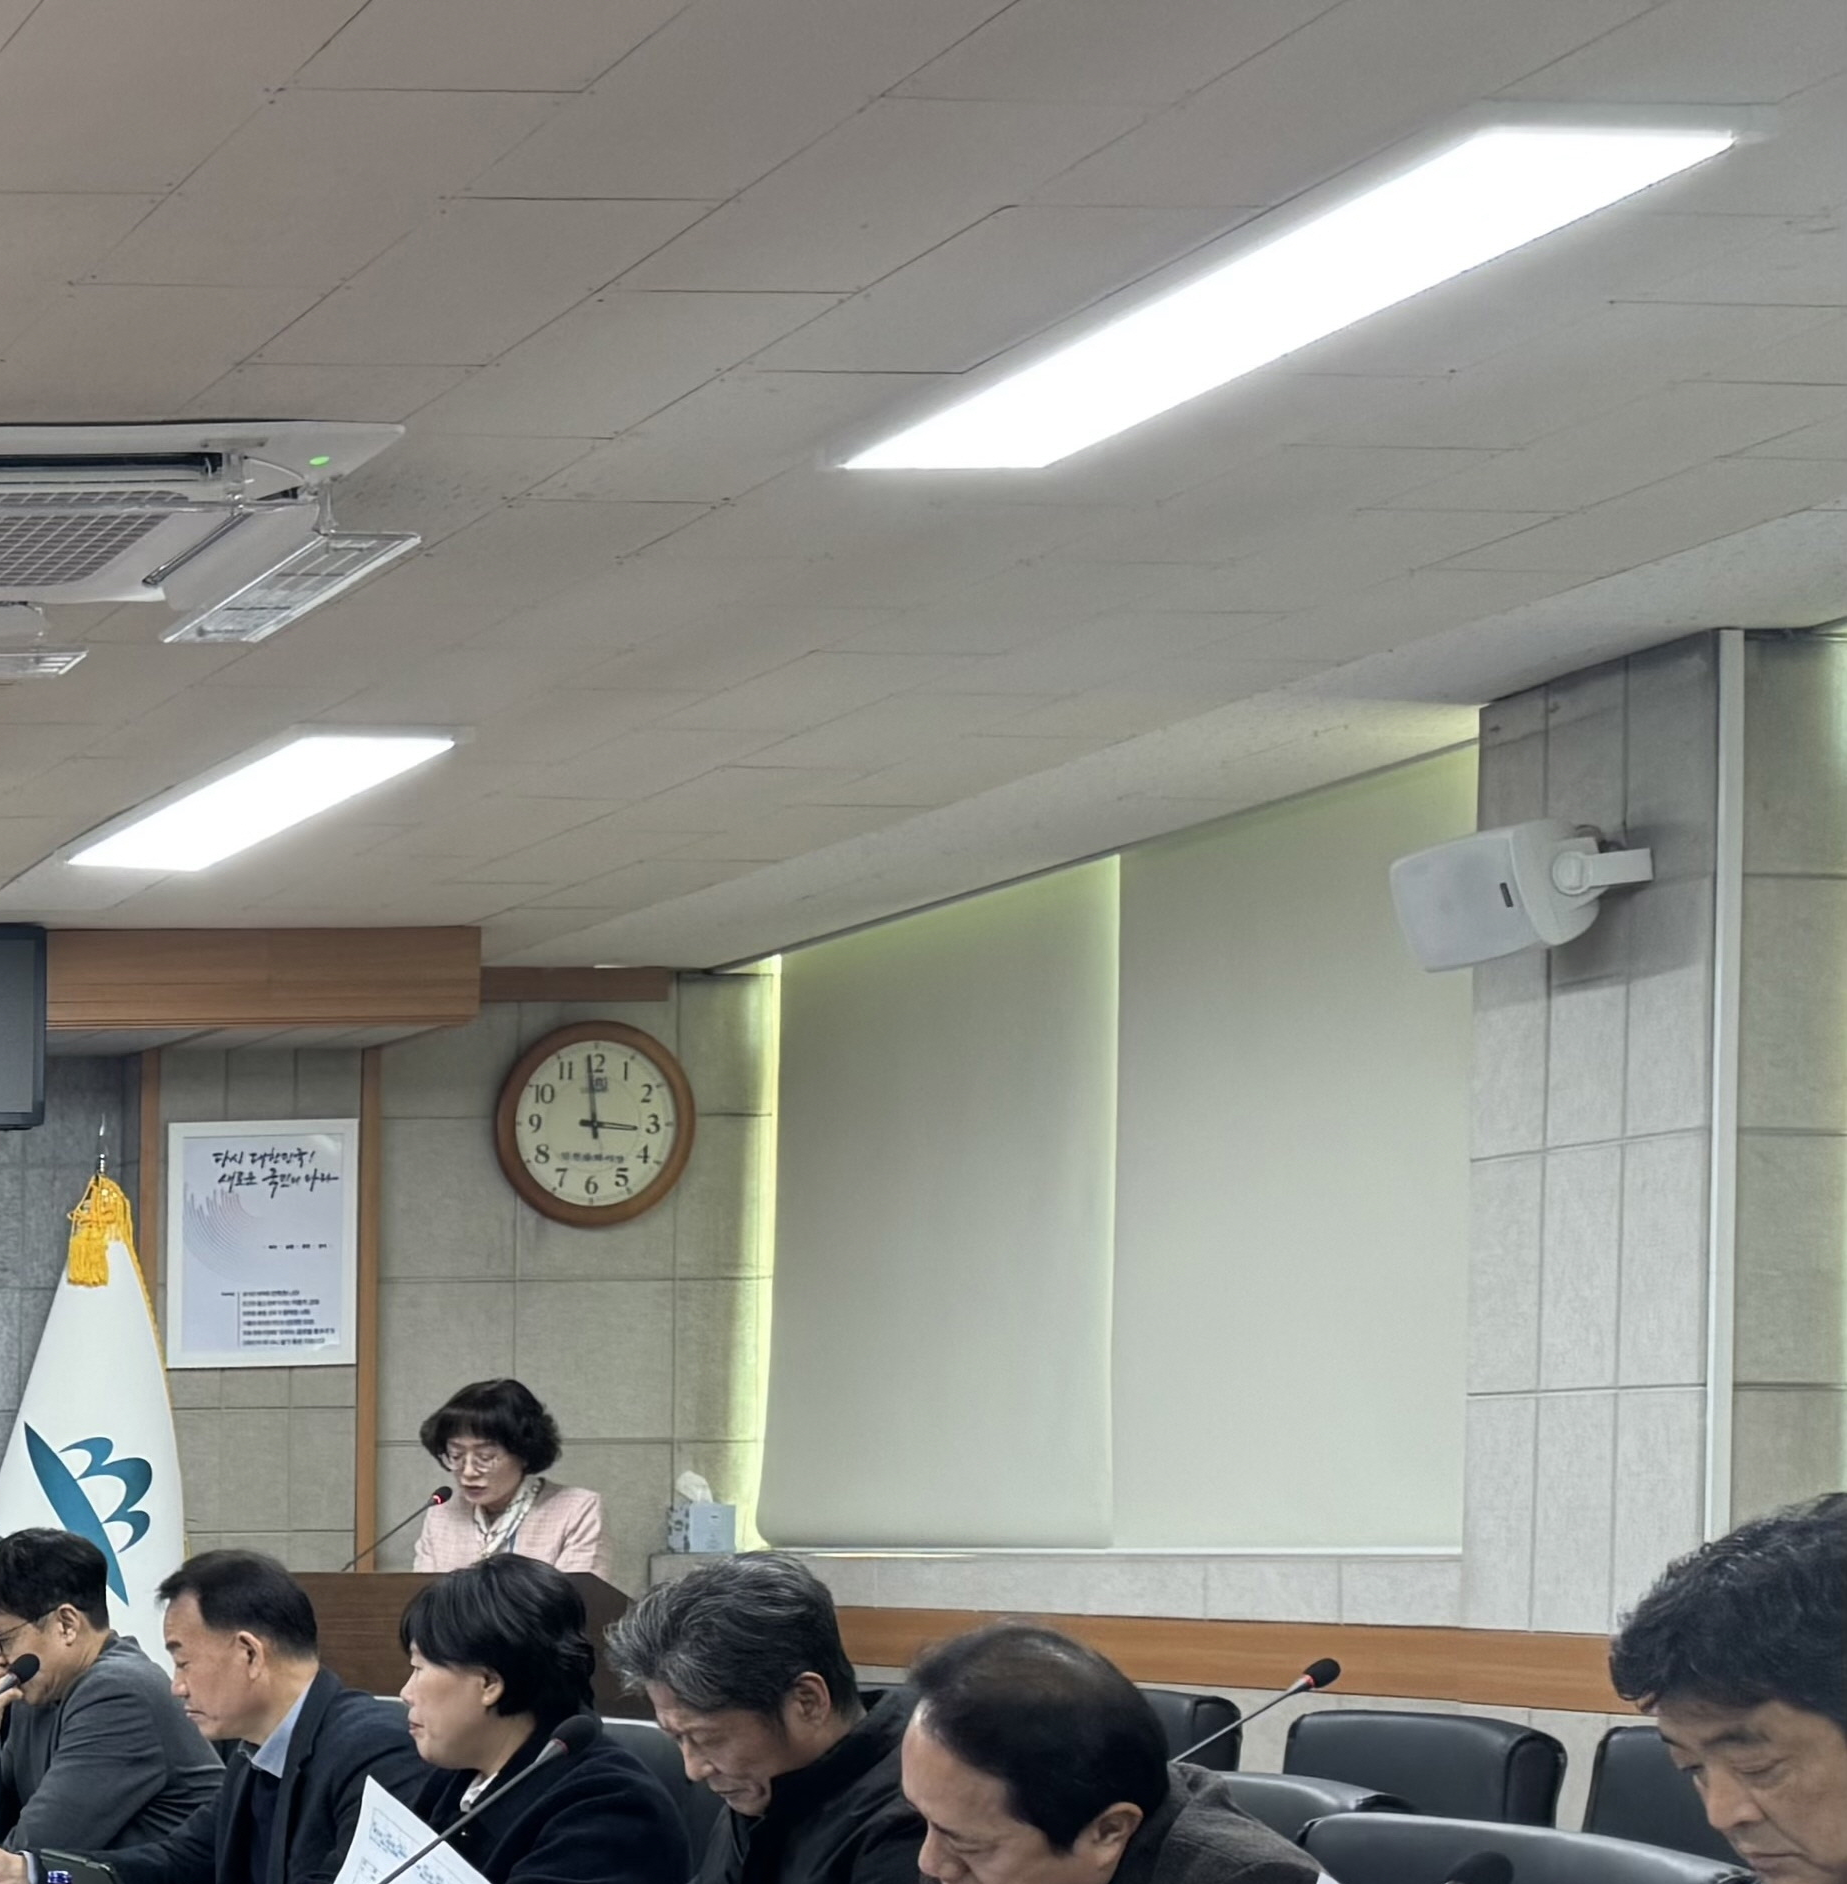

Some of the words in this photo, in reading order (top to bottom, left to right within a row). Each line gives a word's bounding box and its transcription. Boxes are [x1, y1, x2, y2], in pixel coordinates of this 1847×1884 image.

[559, 1061, 573, 1080] 11
[623, 1061, 629, 1081] 1
[534, 1084, 555, 1104] 10
[640, 1084, 652, 1103] 2
[528, 1114, 542, 1133] 9
[645, 1114, 661, 1134] 3
[212, 1150, 244, 1168] 다시
[249, 1146, 316, 1169] 대한민국!
[534, 1145, 550, 1164] 8
[636, 1145, 650, 1164] 4
[217, 1170, 258, 1194] 새로운
[262, 1167, 301, 1199] 국민의
[304, 1168, 340, 1192] 나라
[555, 1168, 568, 1188] 7
[585, 1175, 598, 1195] 6
[615, 1168, 629, 1187] 5
